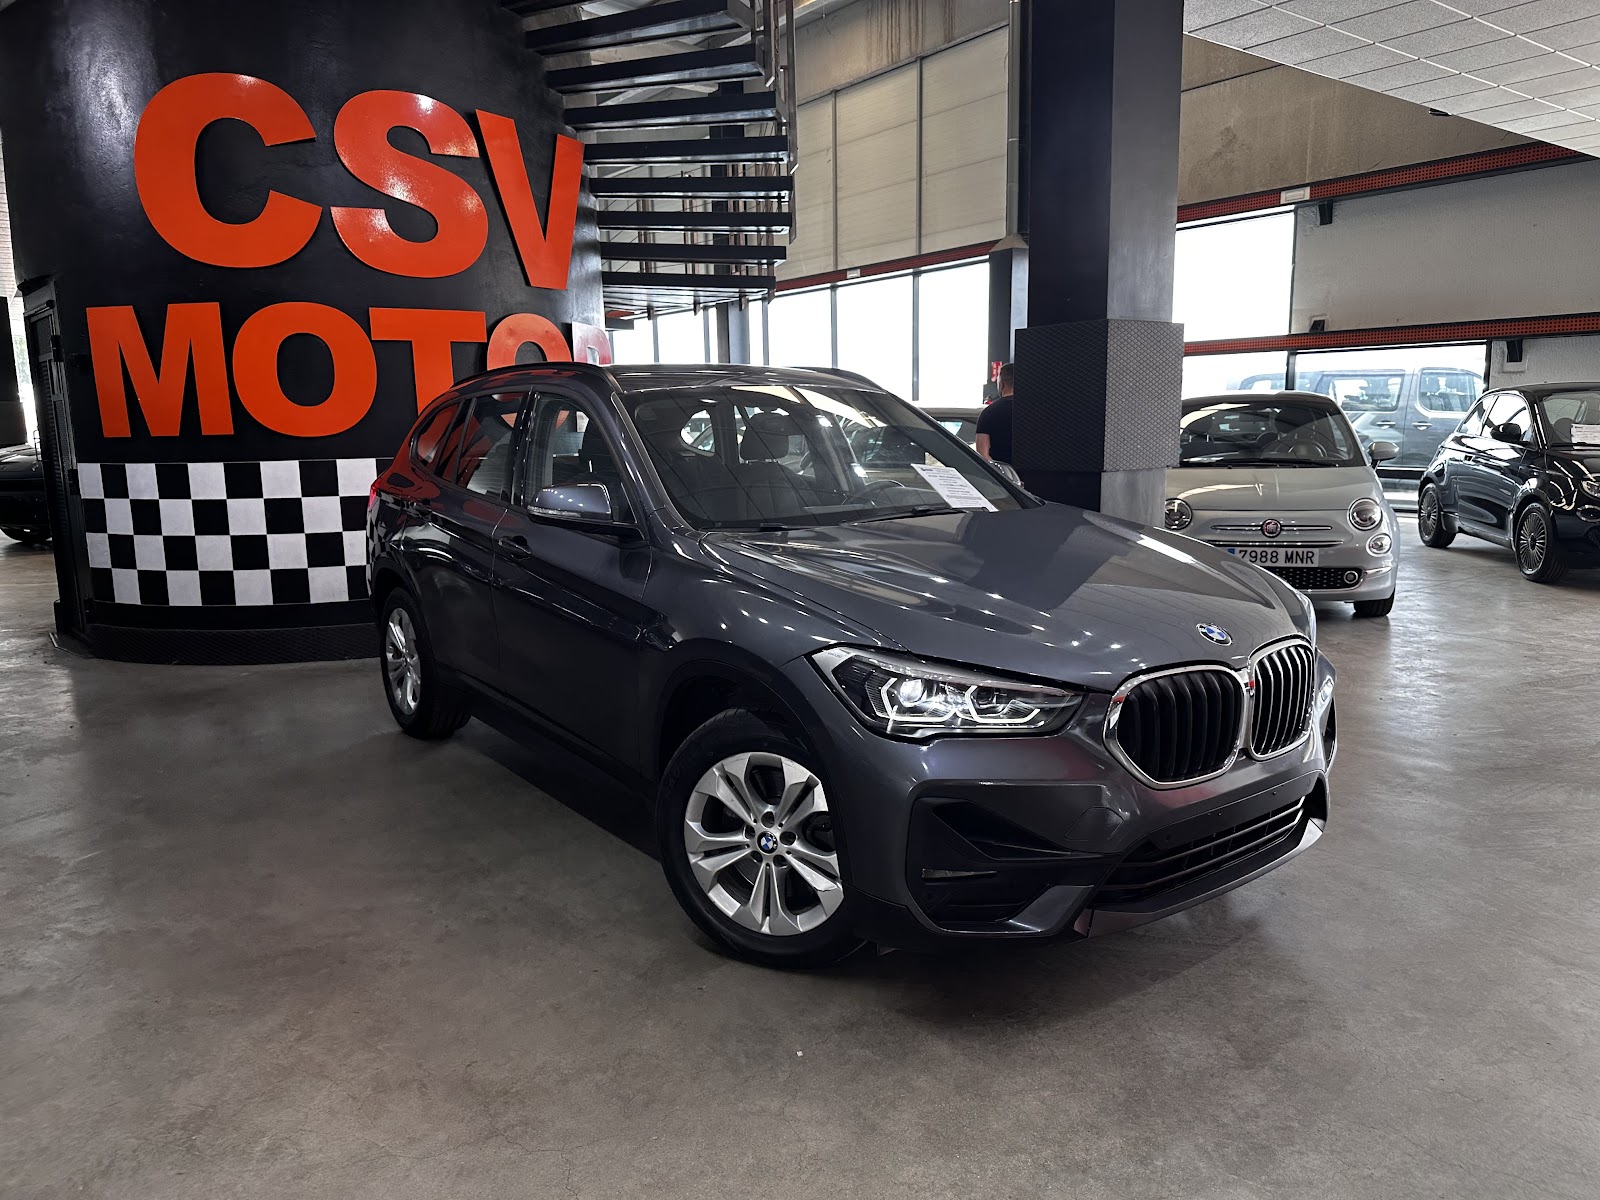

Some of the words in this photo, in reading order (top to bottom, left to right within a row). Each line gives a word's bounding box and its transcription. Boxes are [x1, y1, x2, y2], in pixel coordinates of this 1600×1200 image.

[134, 72, 585, 290] CSV
[1238, 549, 1279, 564] 7988
[1284, 550, 1315, 565] MNR
